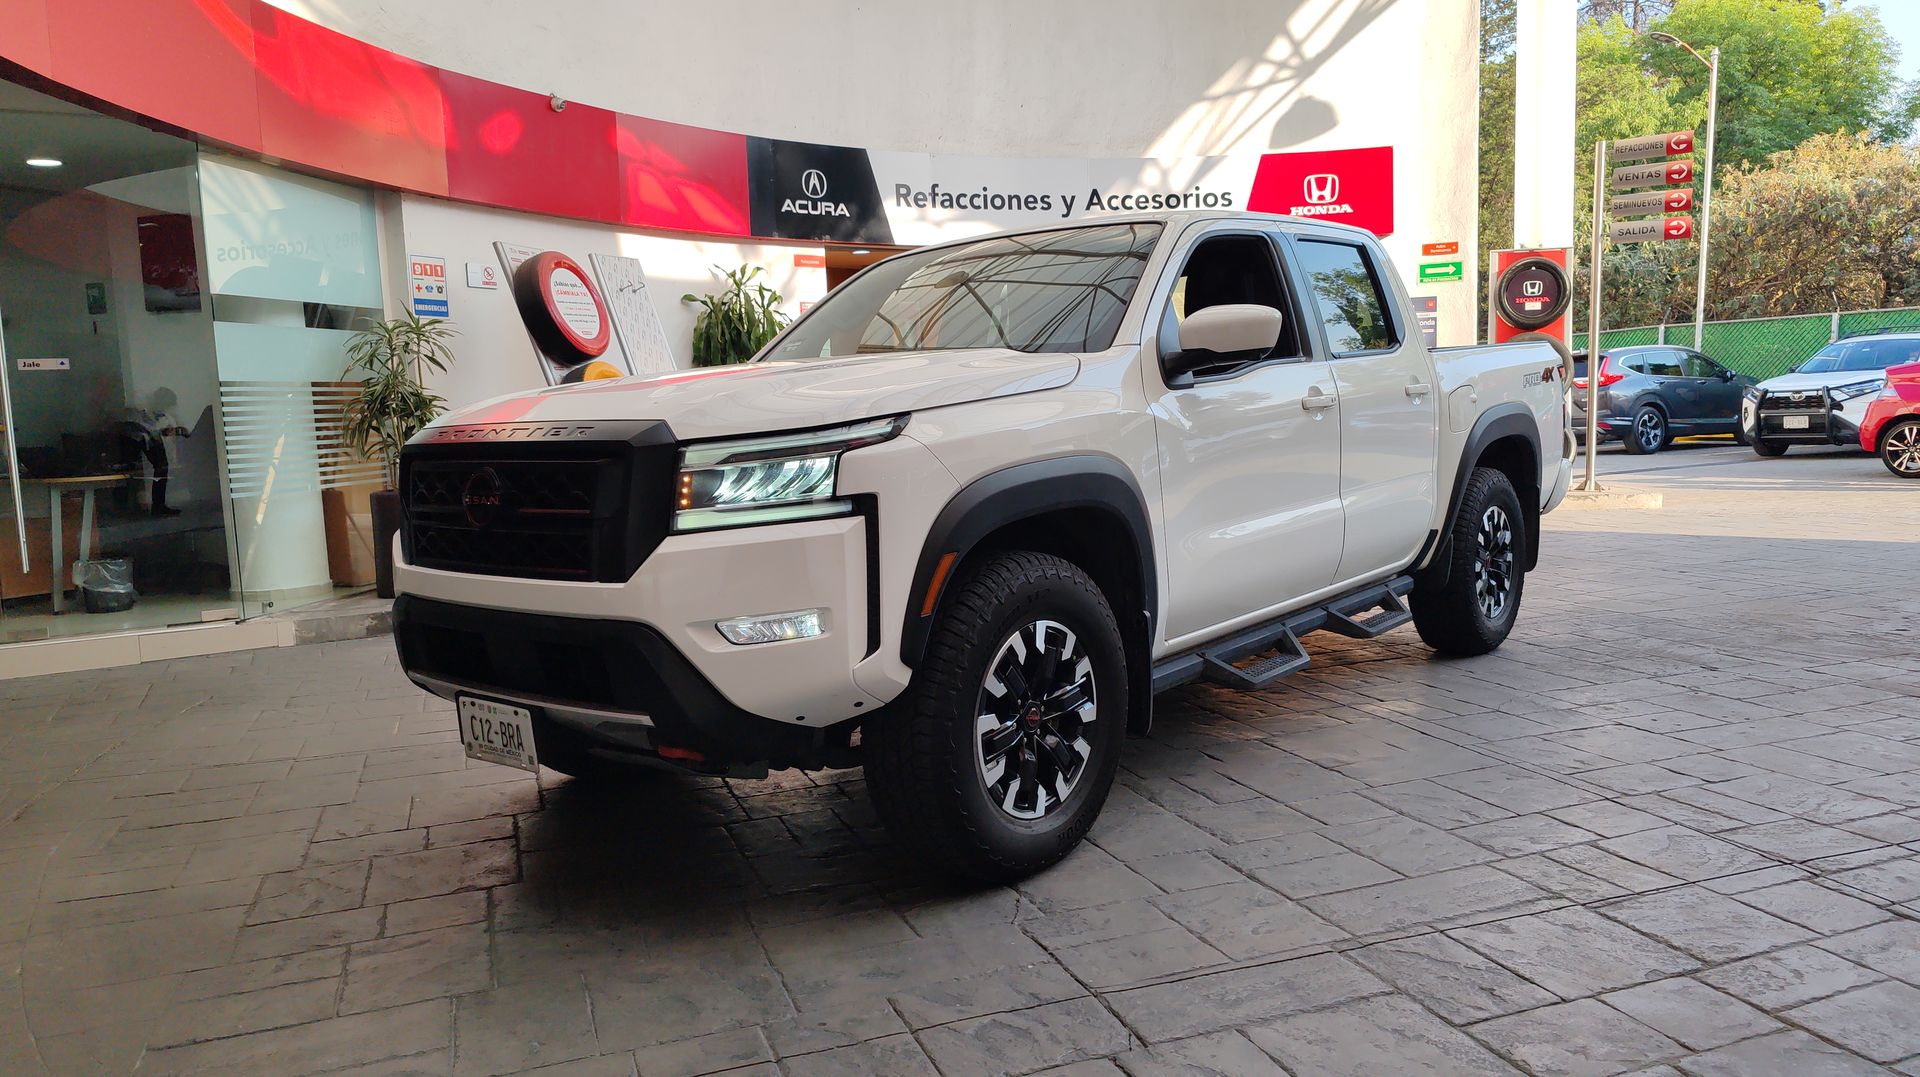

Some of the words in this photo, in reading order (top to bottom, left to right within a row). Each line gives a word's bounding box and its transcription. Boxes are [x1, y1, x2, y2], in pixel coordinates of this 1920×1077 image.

[1615, 141, 1664, 154] REFACCIONES
[1618, 170, 1661, 181] VENTAS
[895, 183, 1052, 210] Refacciones
[1061, 194, 1076, 218] y
[1085, 185, 1233, 211] Accesorios
[1613, 198, 1663, 210] SEMINUEVOS
[781, 199, 850, 217] ACURA
[1290, 204, 1353, 216] HONDA
[1618, 226, 1656, 236] SALIDA
[414, 264, 443, 276] 911
[415, 303, 447, 312] EMERGENCIAS
[433, 426, 594, 440] FRONTIER
[470, 715, 525, 752] C12-BRA
